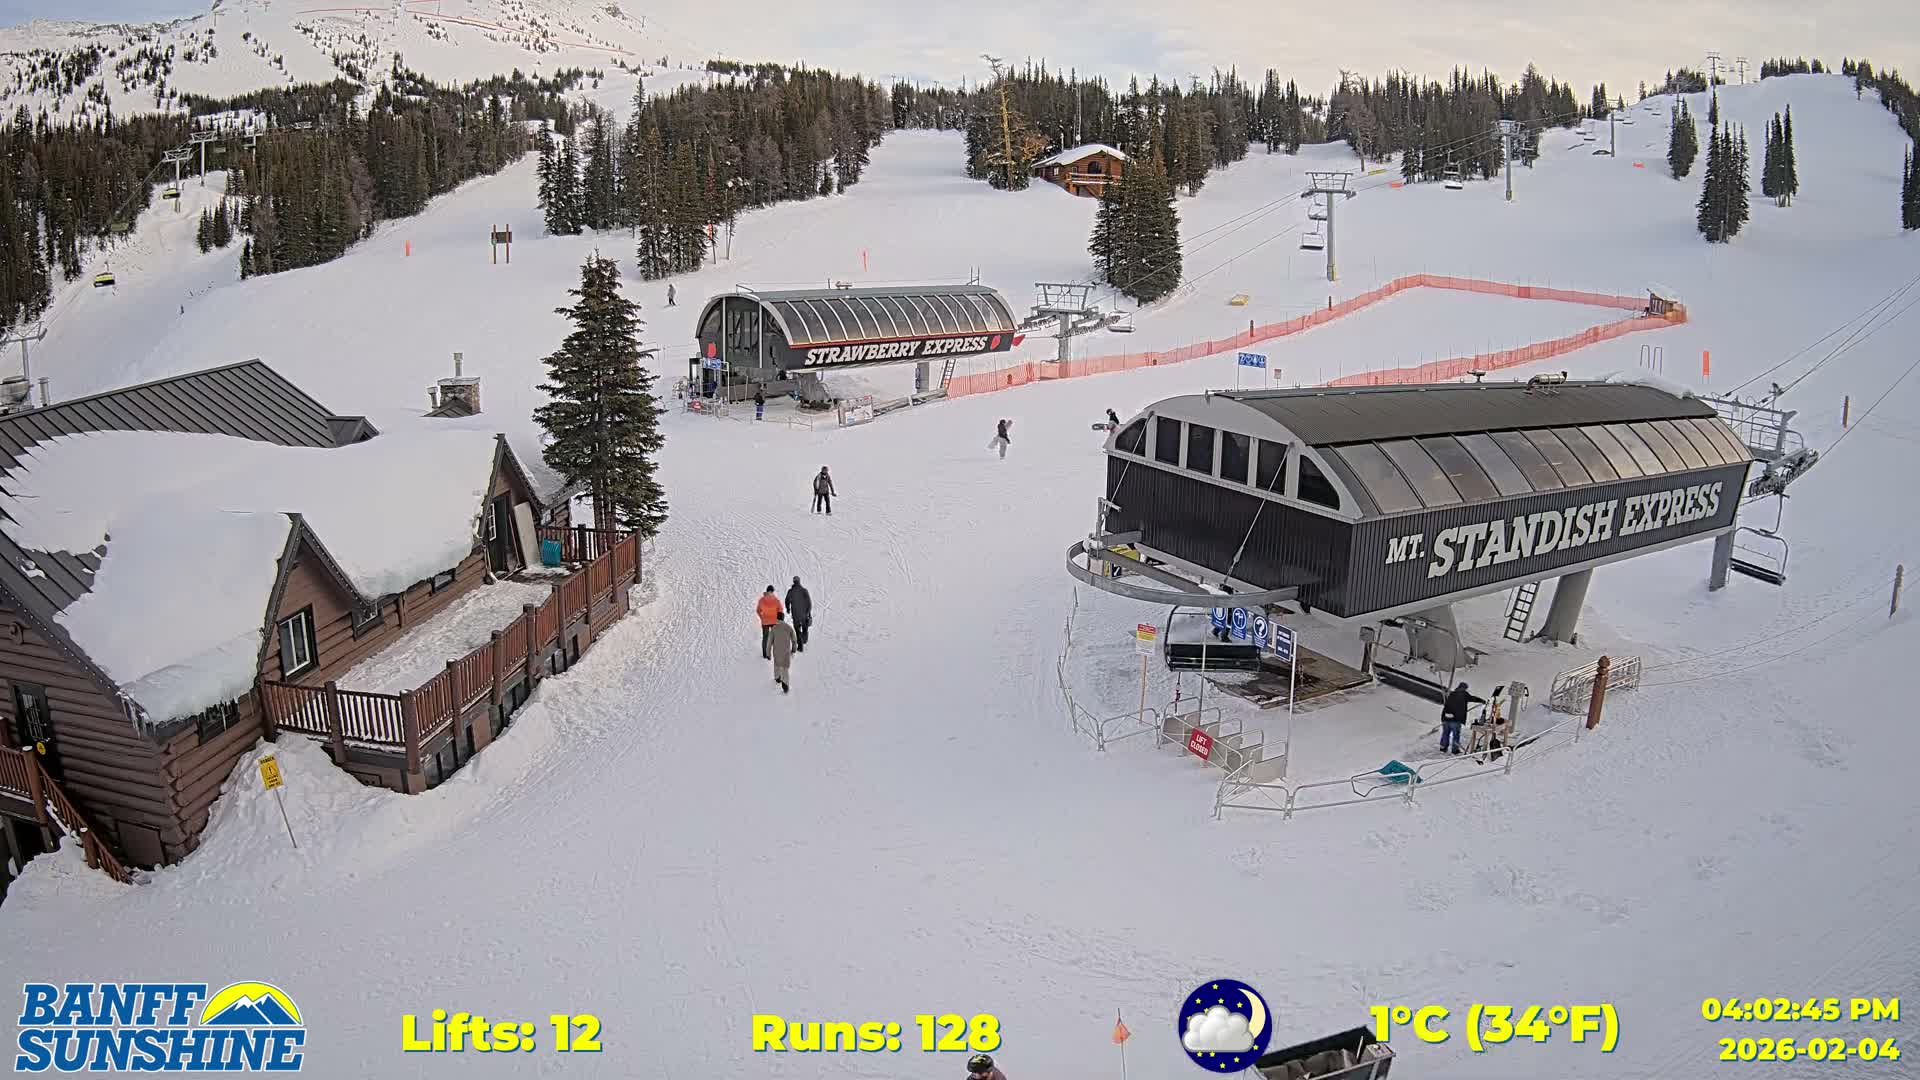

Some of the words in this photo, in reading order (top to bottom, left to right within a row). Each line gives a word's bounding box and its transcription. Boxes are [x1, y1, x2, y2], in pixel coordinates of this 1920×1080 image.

[804, 341, 921, 366] STRAWBERRY
[922, 337, 988, 355] EXPRESS
[1385, 534, 1425, 564] MT.
[1427, 499, 1617, 579] STANDISH
[1618, 481, 1723, 537] EXPRESS
[1190, 740, 1209, 756] CLOSED
[1195, 734, 1208, 745] LIFT
